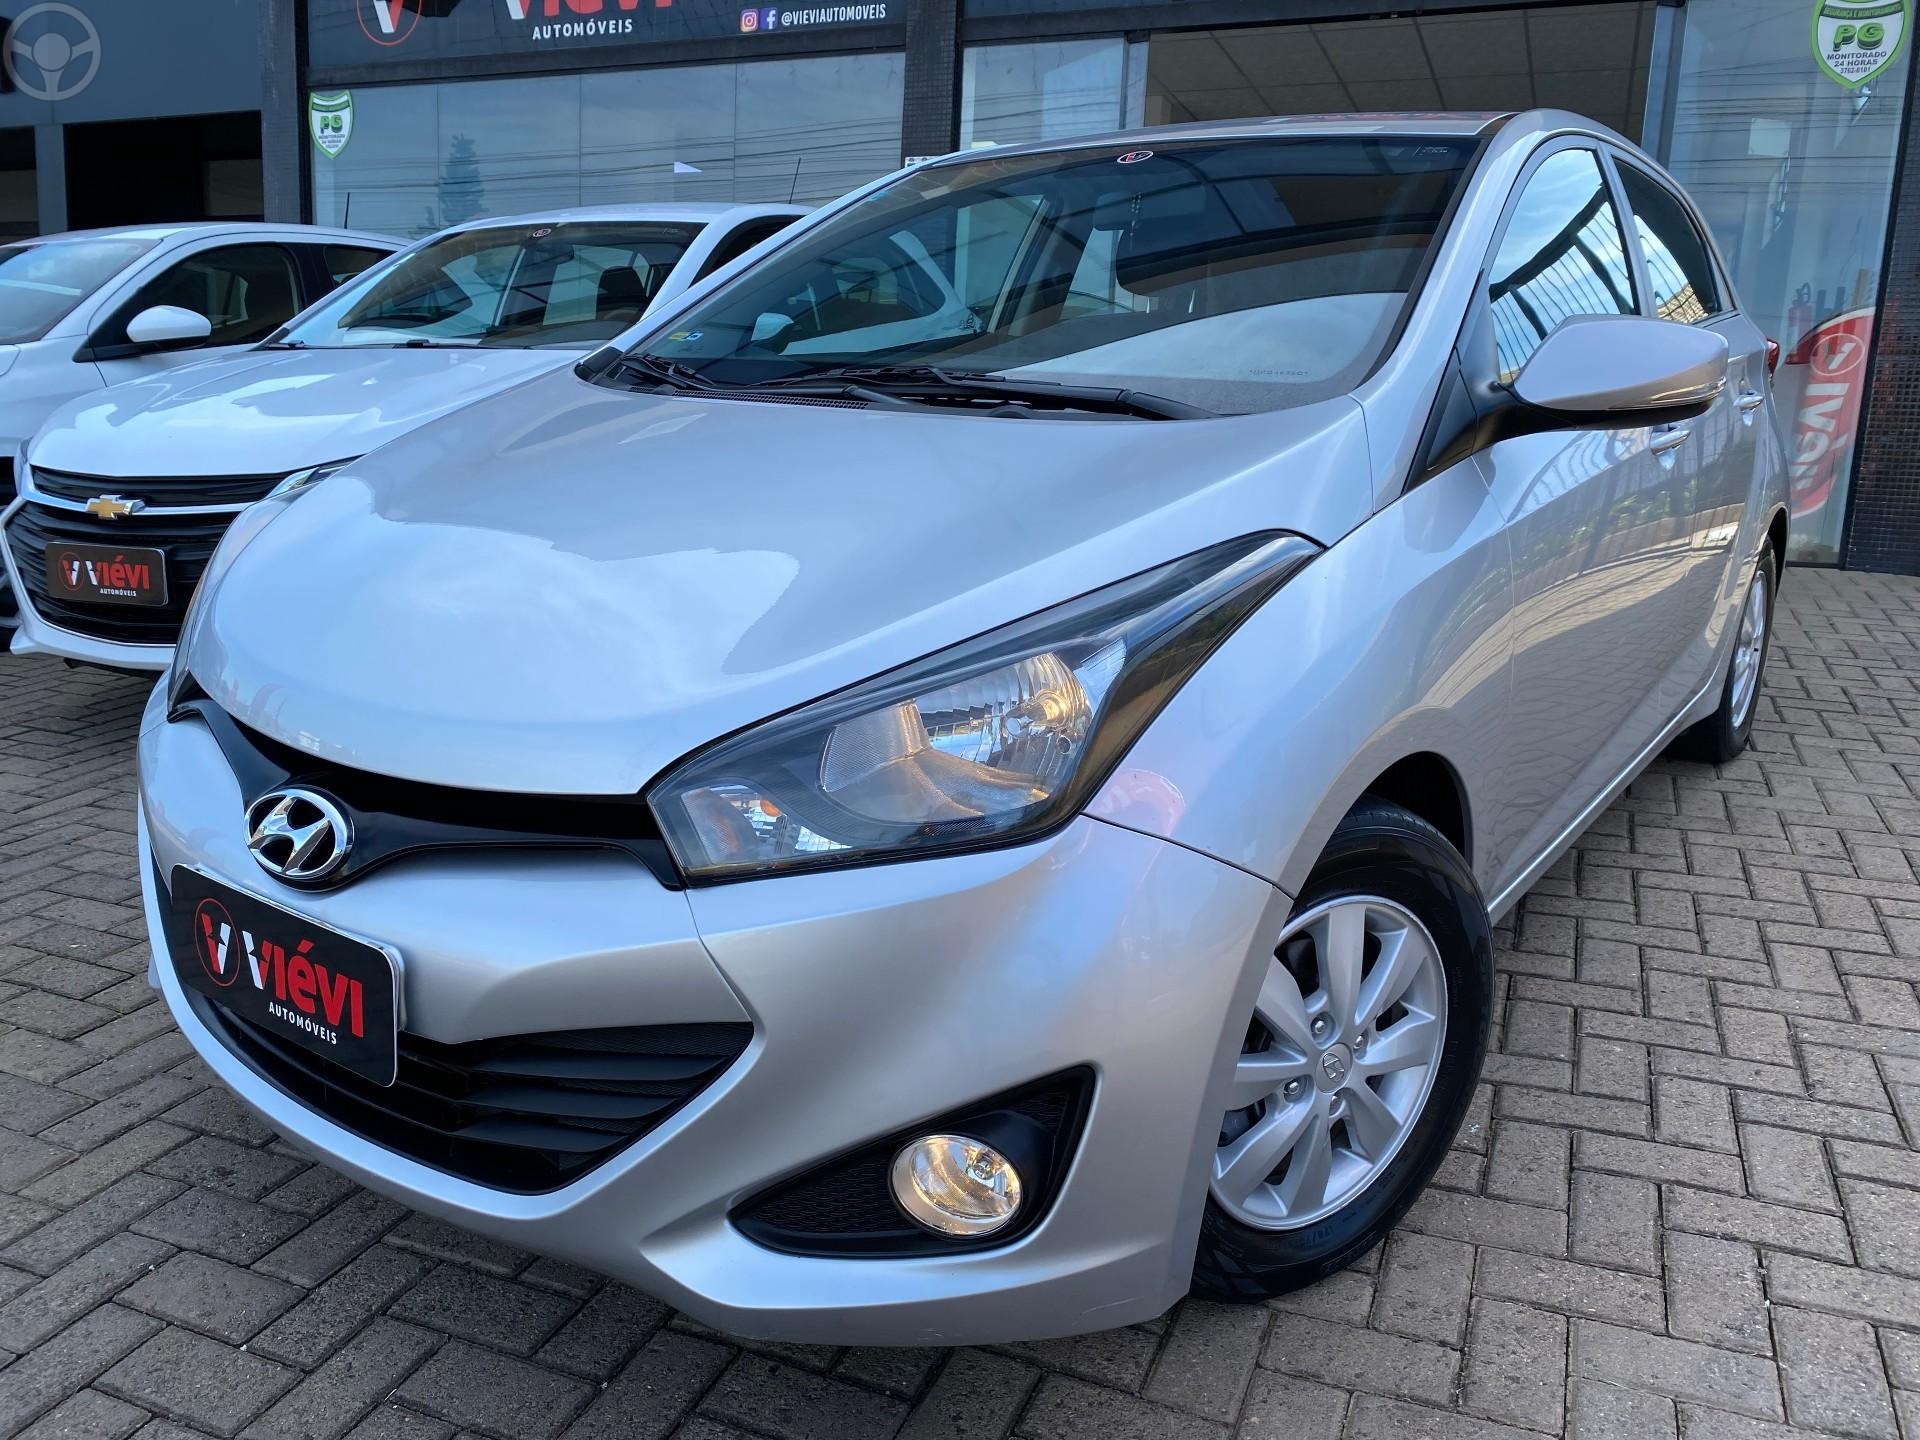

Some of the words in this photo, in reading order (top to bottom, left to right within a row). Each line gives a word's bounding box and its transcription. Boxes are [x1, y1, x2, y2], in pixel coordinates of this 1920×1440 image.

[781, 3, 887, 26] @VIEVIAUTOMOVEIS
[532, 18, 634, 40] AUTOMÓVEIS
[1833, 22, 1885, 52] PG
[1828, 51, 1886, 60] MONITORADO
[1847, 59, 1878, 67] HORAS
[100, 588, 137, 597] AUTOMÓVEIS
[268, 1001, 338, 1045] AUTOMÓVEIS
